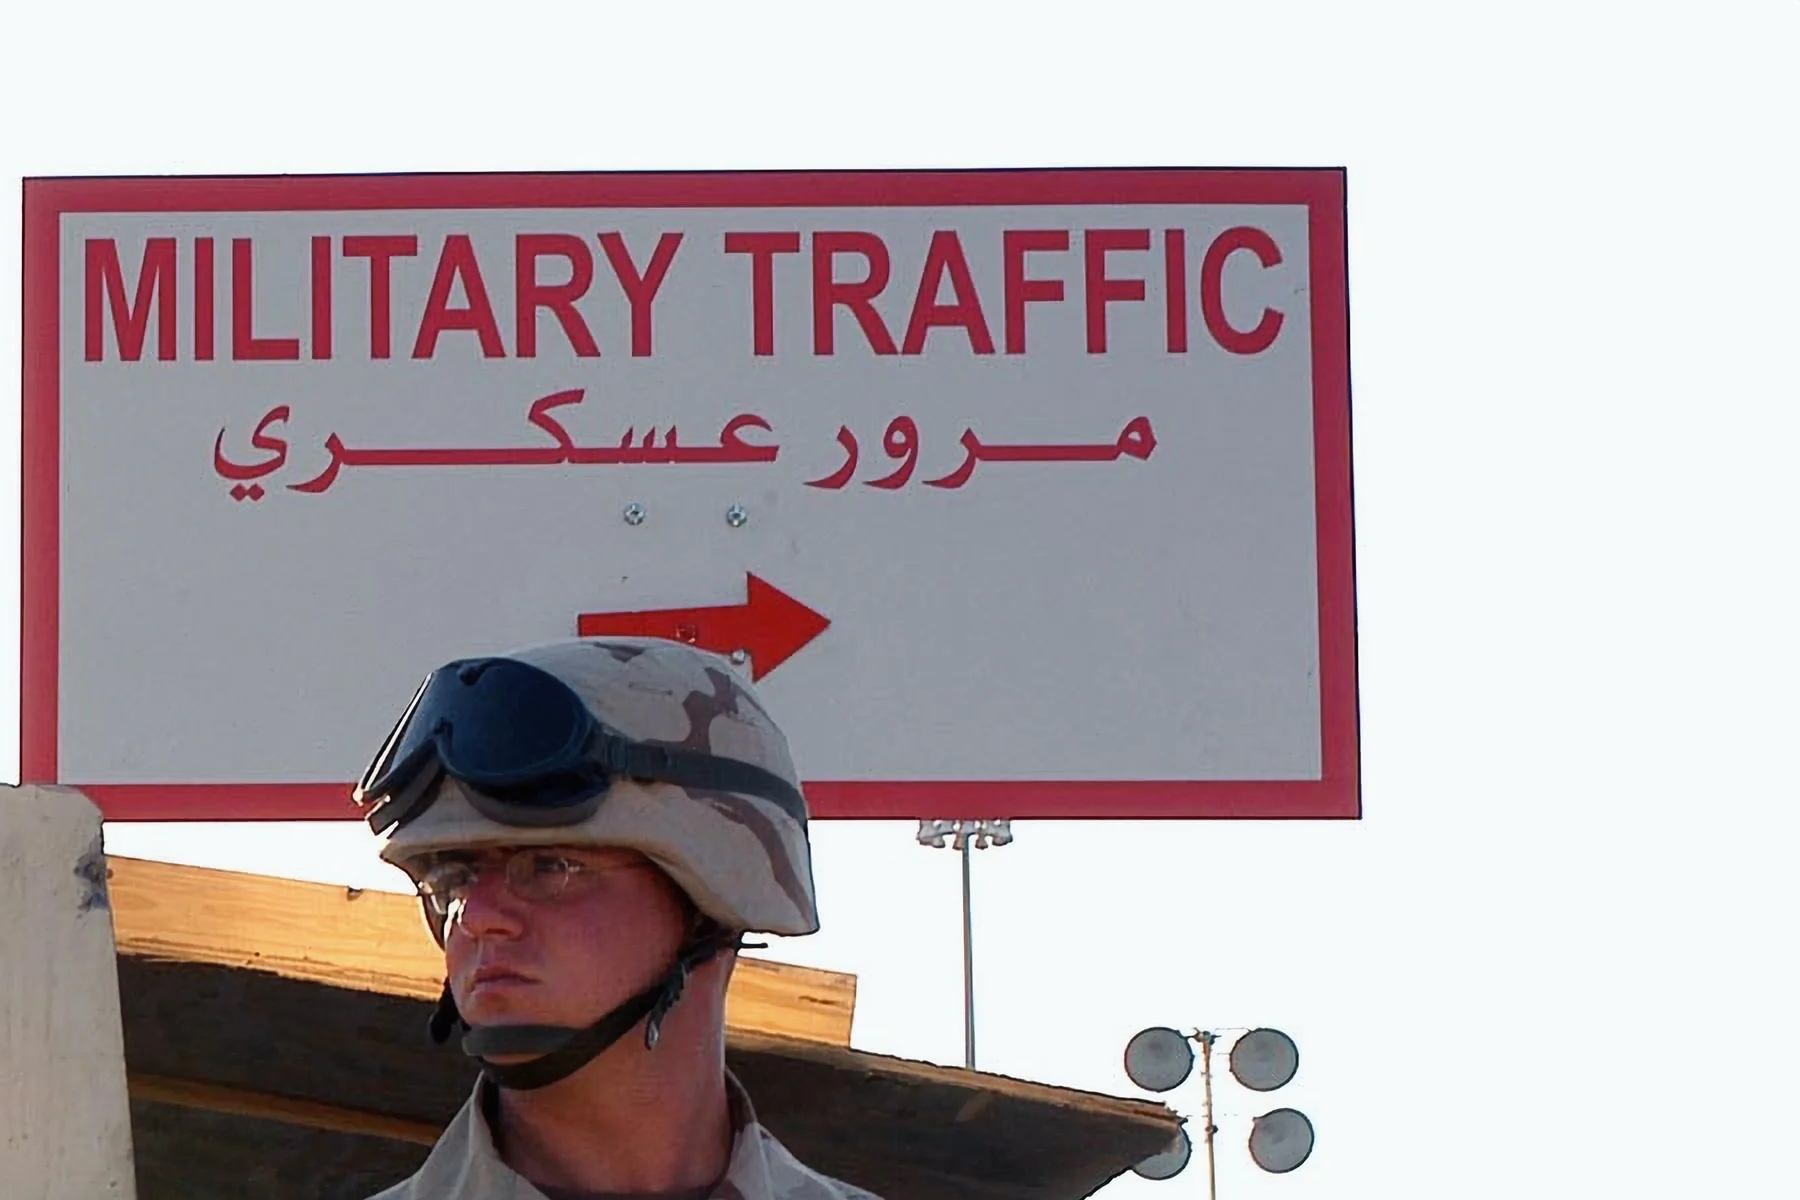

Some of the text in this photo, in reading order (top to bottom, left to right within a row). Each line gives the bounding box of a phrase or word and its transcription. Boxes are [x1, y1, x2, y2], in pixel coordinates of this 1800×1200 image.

[84, 226, 1284, 362] MILITARY TRAFFIC
[212, 388, 1157, 502] مرور عسكري
